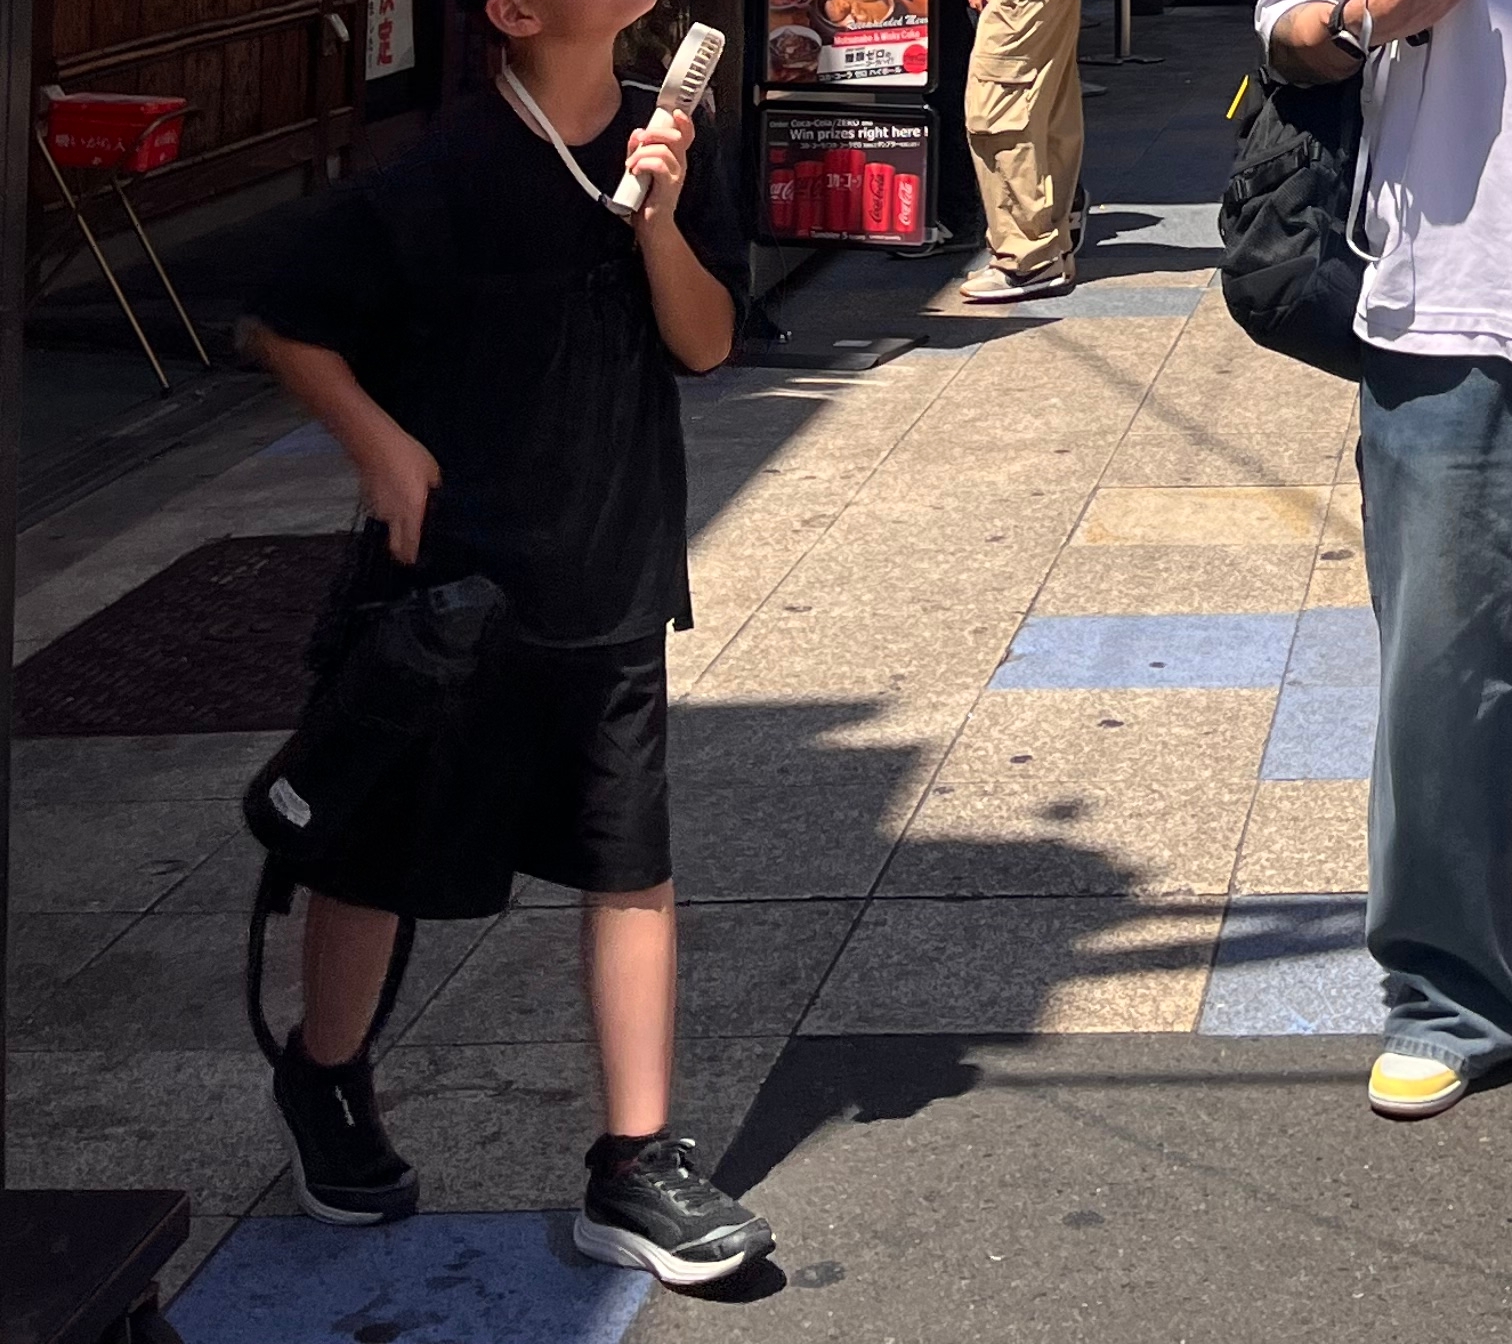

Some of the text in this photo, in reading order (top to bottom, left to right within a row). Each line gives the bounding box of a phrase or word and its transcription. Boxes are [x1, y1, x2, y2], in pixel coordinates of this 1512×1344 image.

[790, 128, 815, 141] Win
[817, 126, 856, 142] prizes
[857, 126, 889, 142] right
[891, 125, 922, 138] here
